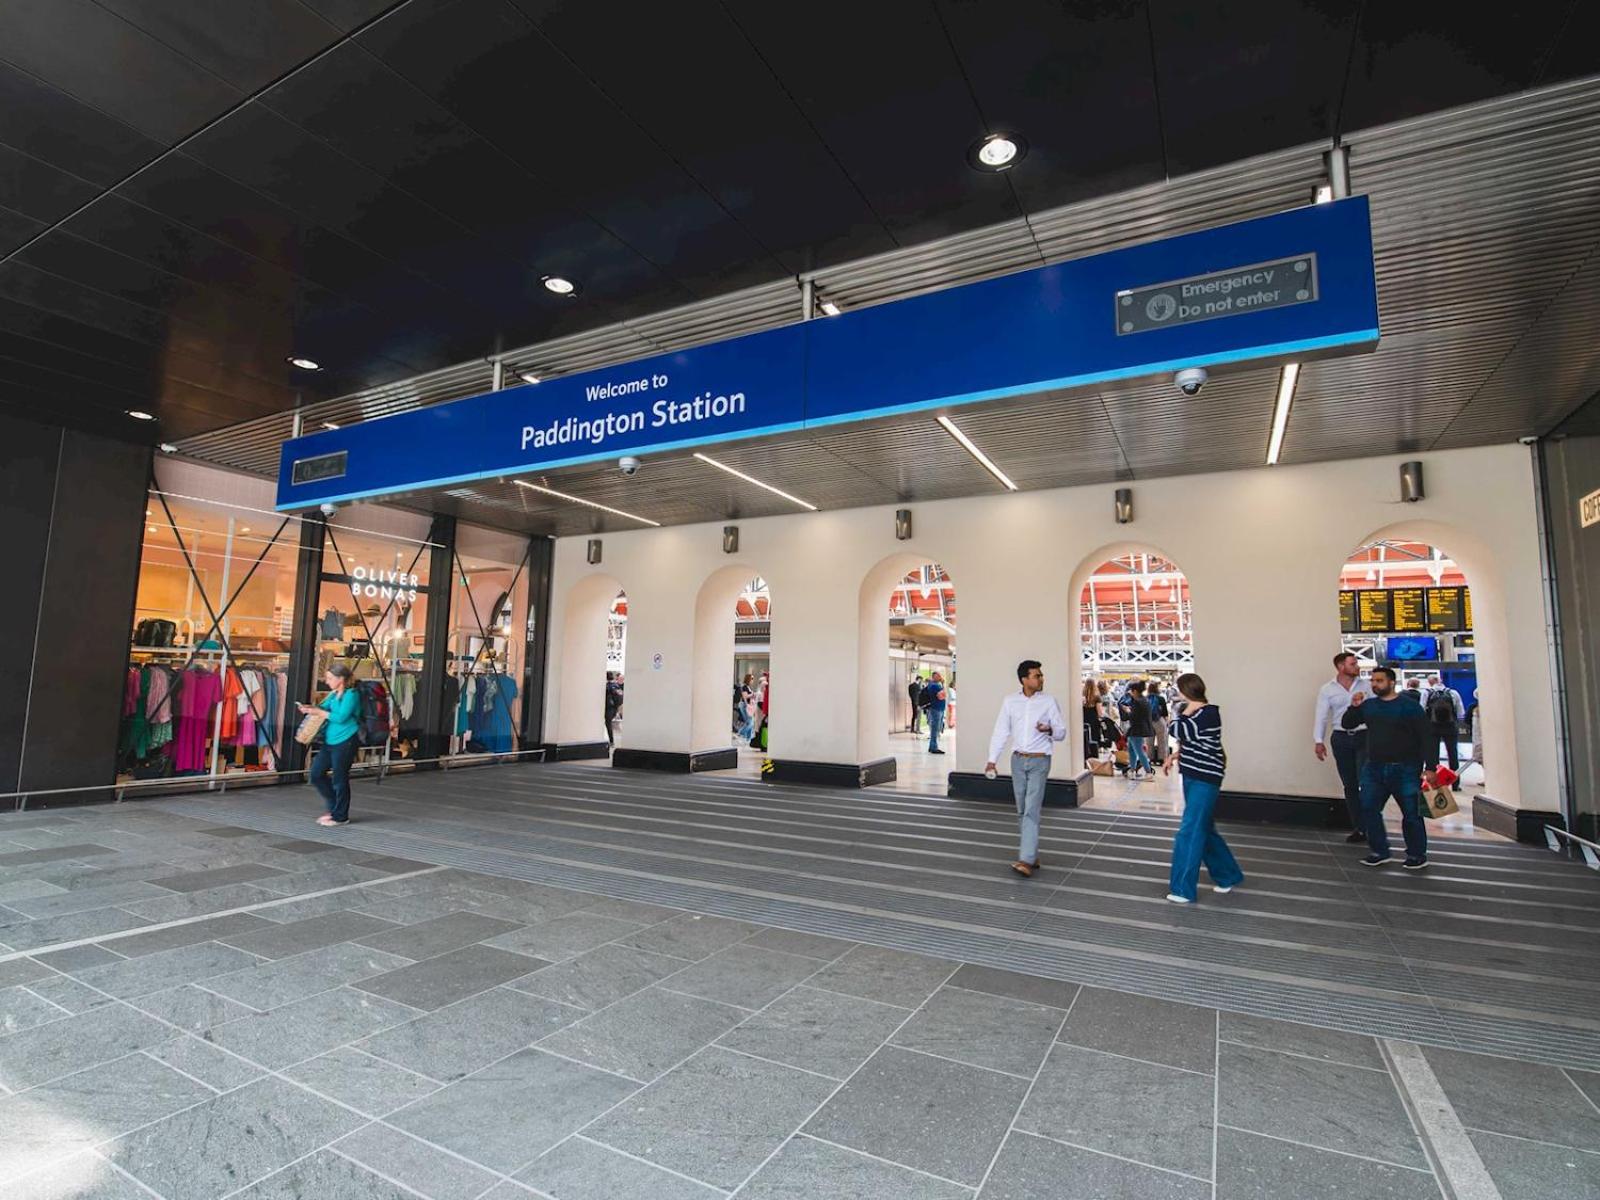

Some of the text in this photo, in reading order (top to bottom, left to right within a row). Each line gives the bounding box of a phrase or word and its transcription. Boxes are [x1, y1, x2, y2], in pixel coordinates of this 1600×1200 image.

[1182, 270, 1275, 297] Emergency
[1179, 290, 1281, 318] Do not enter
[586, 374, 669, 402] Welcome to
[521, 391, 746, 450] Paddington Station
[353, 566, 418, 587] OLIVER
[352, 582, 418, 603] BONAS
